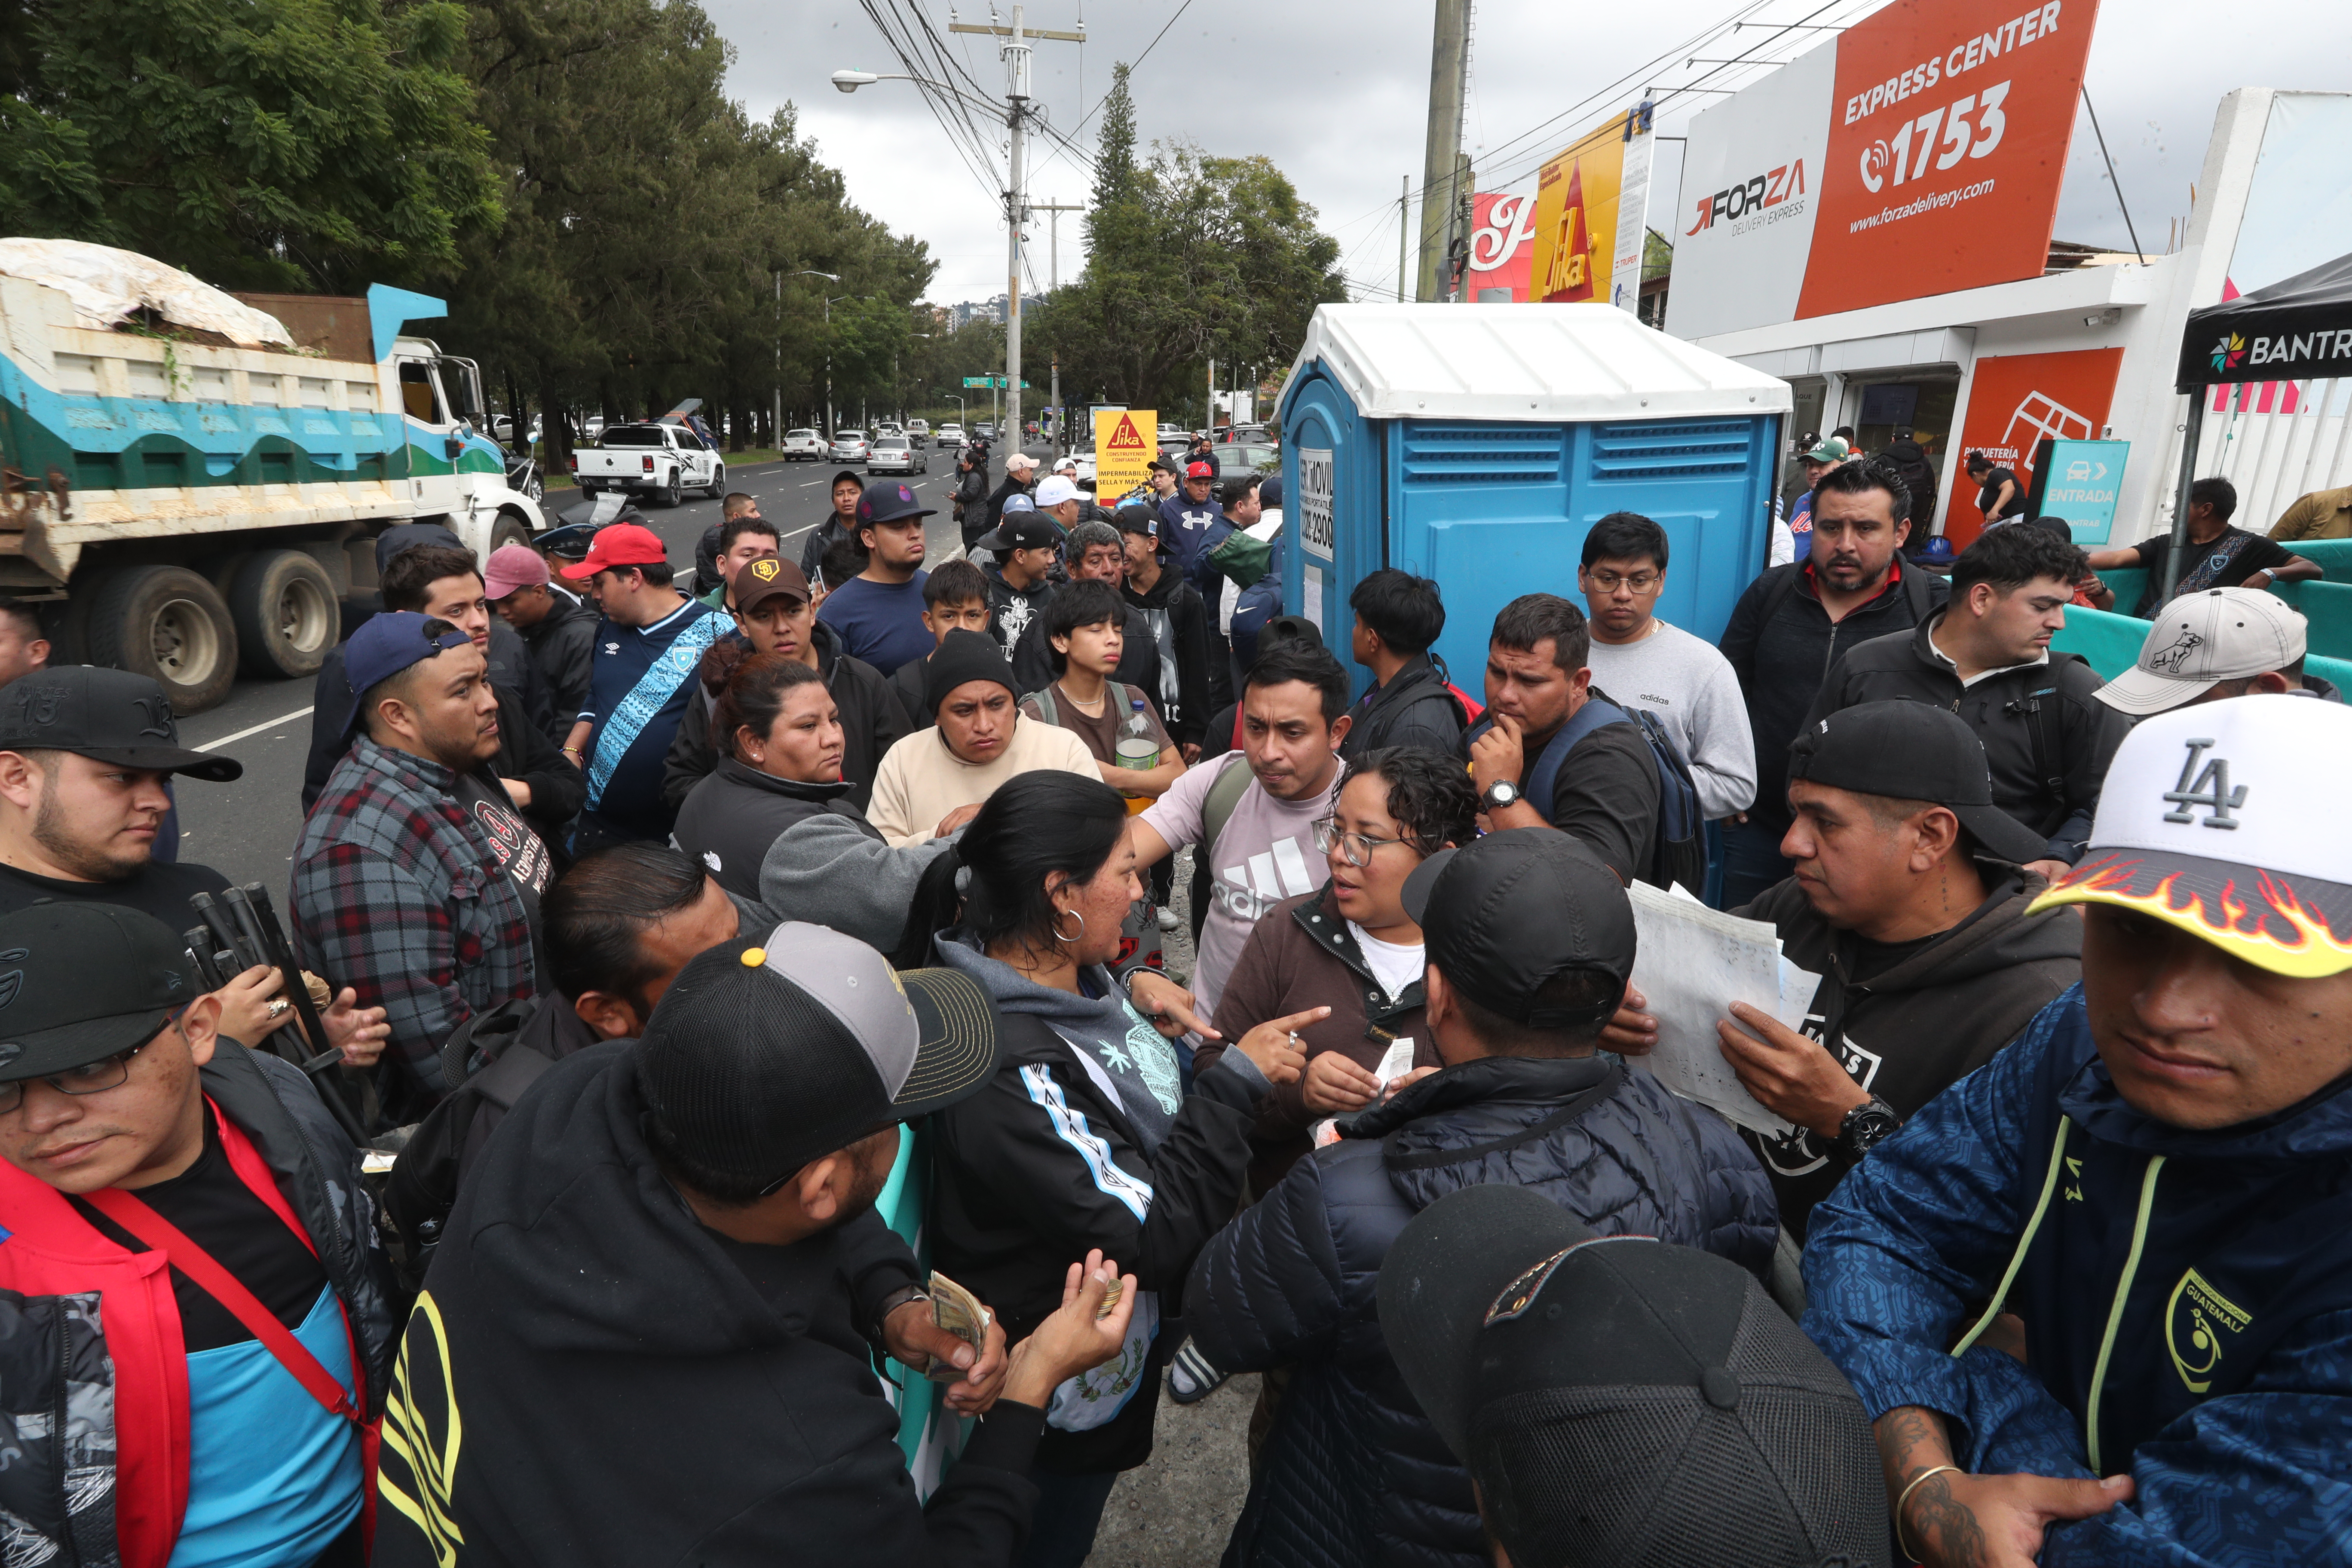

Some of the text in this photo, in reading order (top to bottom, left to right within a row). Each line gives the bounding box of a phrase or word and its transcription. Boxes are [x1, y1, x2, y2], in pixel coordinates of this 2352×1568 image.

[1844, 0, 2061, 126] EXPRESS CENTER
[1891, 80, 2011, 187] 1753
[1710, 158, 1805, 228] FORZA
[1850, 178, 1995, 234] www.forzadelivery.com
[1732, 200, 1804, 237] DELIVERY EXPRESS
[1544, 207, 1585, 296] Sika
[1620, 255, 1638, 267] TRUPER
[1112, 425, 1139, 445] Sika
[1963, 459, 1968, 468] Y
[2048, 489, 2113, 502] ENTRADA
[759, 562, 772, 576] SD
[1640, 694, 1669, 705] adidas
[2163, 737, 2249, 830] LA
